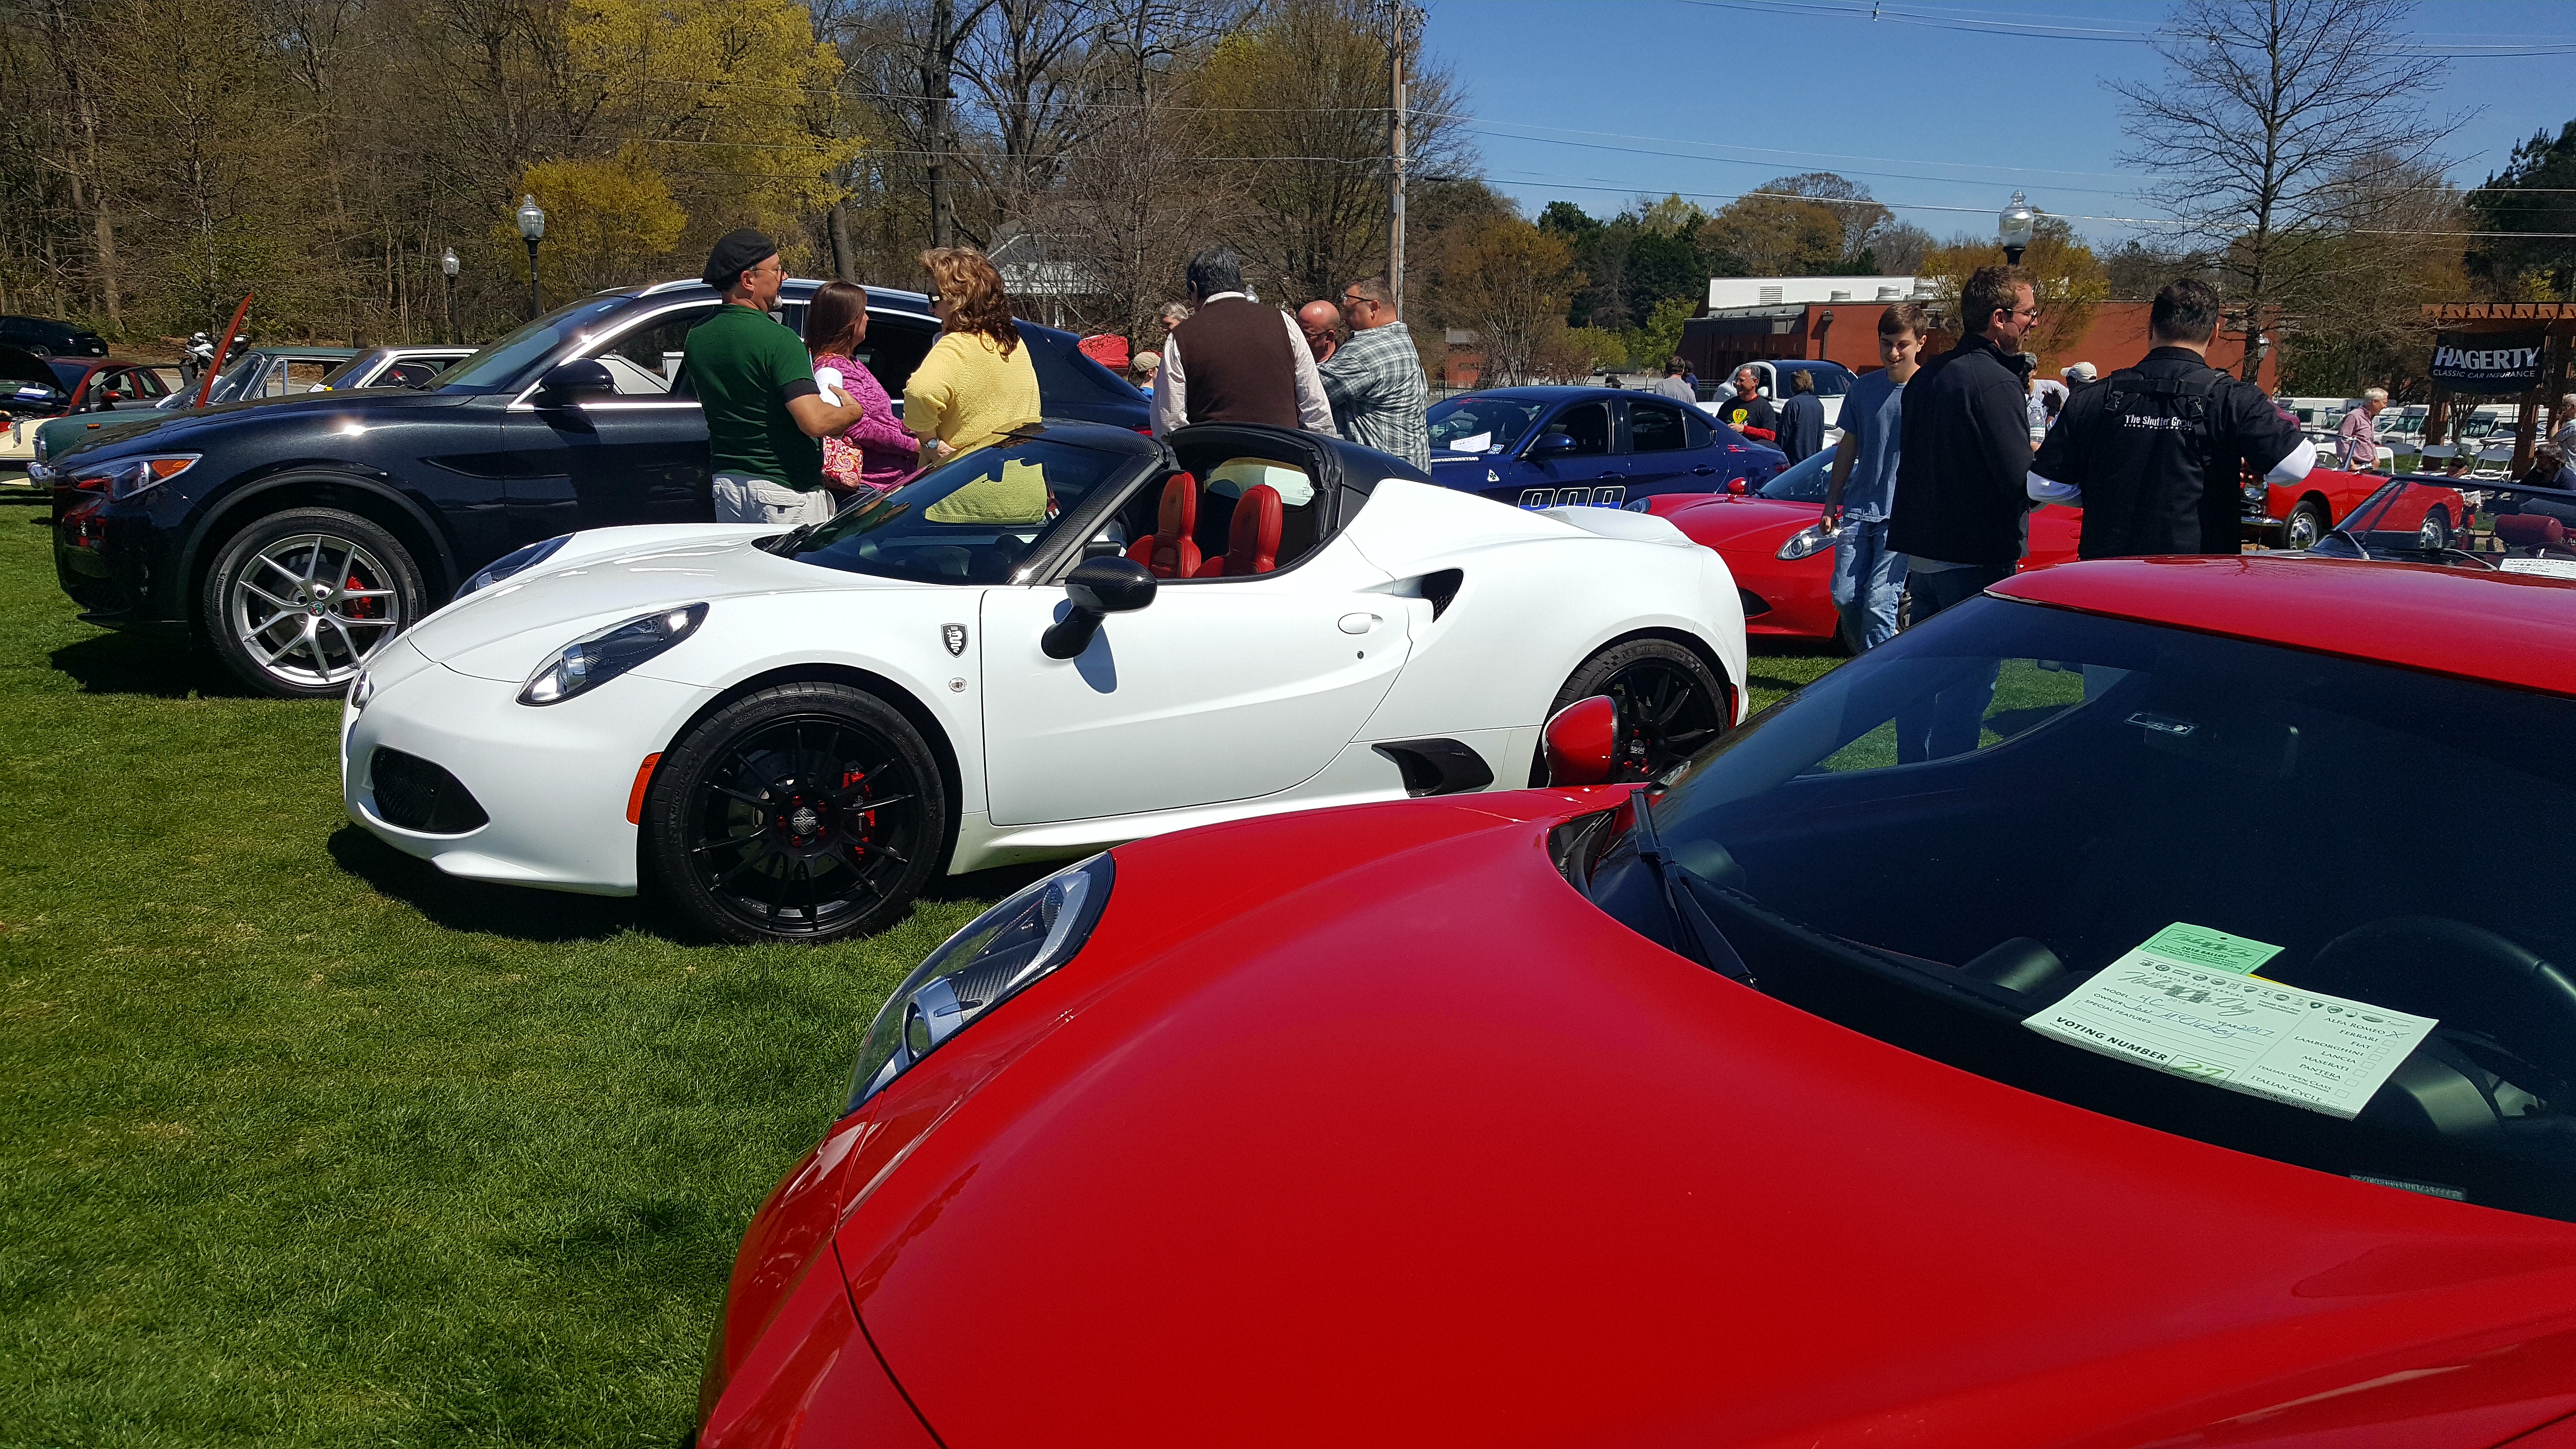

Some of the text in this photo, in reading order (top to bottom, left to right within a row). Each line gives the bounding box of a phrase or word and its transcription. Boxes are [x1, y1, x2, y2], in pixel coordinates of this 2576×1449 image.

[2434, 346, 2540, 370] HAGERTY
[2433, 369, 2465, 377] CLASSIC
[2486, 370, 2535, 378] INSURANCE
[2125, 414, 2193, 427] The Shutter Grou
[2102, 987, 2129, 998] MODEL
[2150, 971, 2189, 984] ATLANTA'S
[2214, 988, 2244, 998] ANNUAL
[2139, 995, 2165, 1007] 4C
[2084, 999, 2152, 1024] SPECIAL FEATURES
[2218, 1020, 2238, 1029] YEAR
[2237, 1024, 2275, 1037] 2017
[2324, 1017, 2385, 1034] ALFA ROMEO
[2056, 1016, 2106, 1039] VOTING
[2107, 1037, 2168, 1062] NUMBER
[2339, 1029, 2378, 1042] FERRARI
[2295, 1036, 2364, 1056] LAMBORGHINI
[2351, 1041, 2372, 1049] FIAT
[2302, 1055, 2349, 1071] MASERATI
[2320, 1051, 2356, 1064] LANCIA
[2258, 1064, 2332, 1090] ITALIAN OPEN CLASS
[2299, 1063, 2341, 1079] PANTERA
[2251, 1075, 2322, 1102] ITALIAN CYCLE
